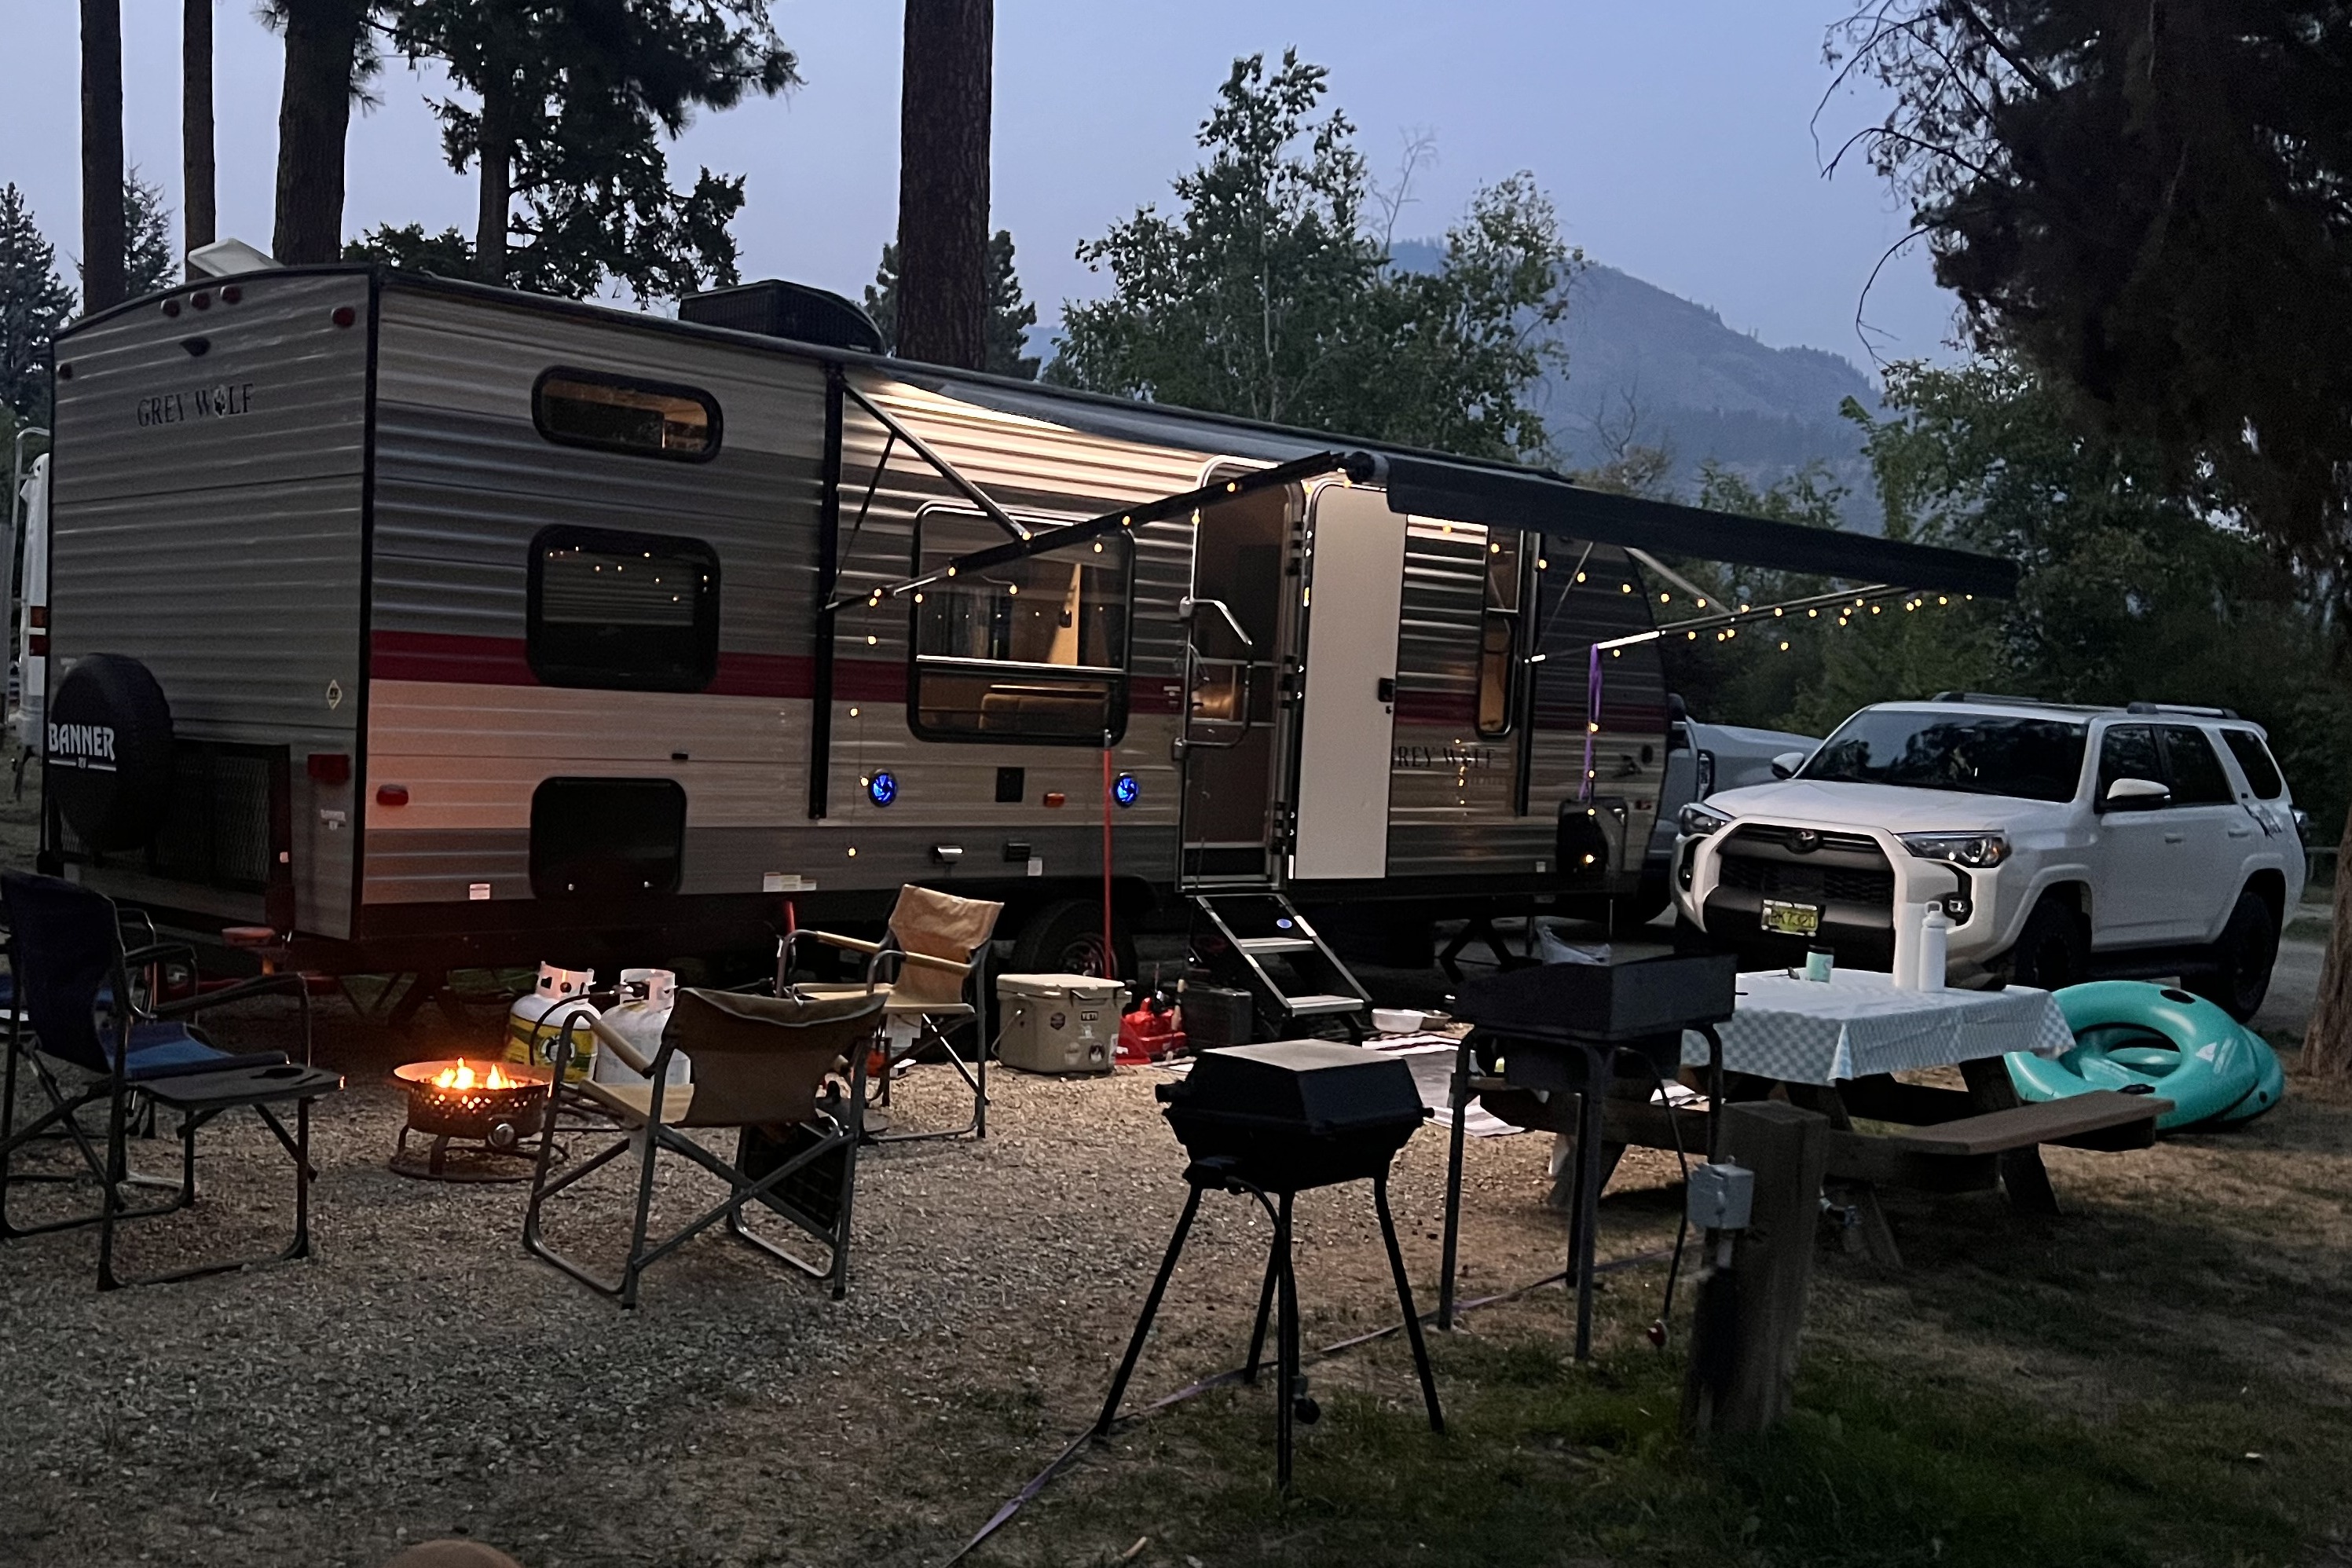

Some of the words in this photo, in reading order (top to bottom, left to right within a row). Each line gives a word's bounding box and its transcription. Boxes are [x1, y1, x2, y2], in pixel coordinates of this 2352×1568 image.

[137, 393, 188, 427] GREY
[195, 383, 254, 419] WOLF
[48, 723, 116, 761] BANNER
[1392, 746, 1436, 768] REY
